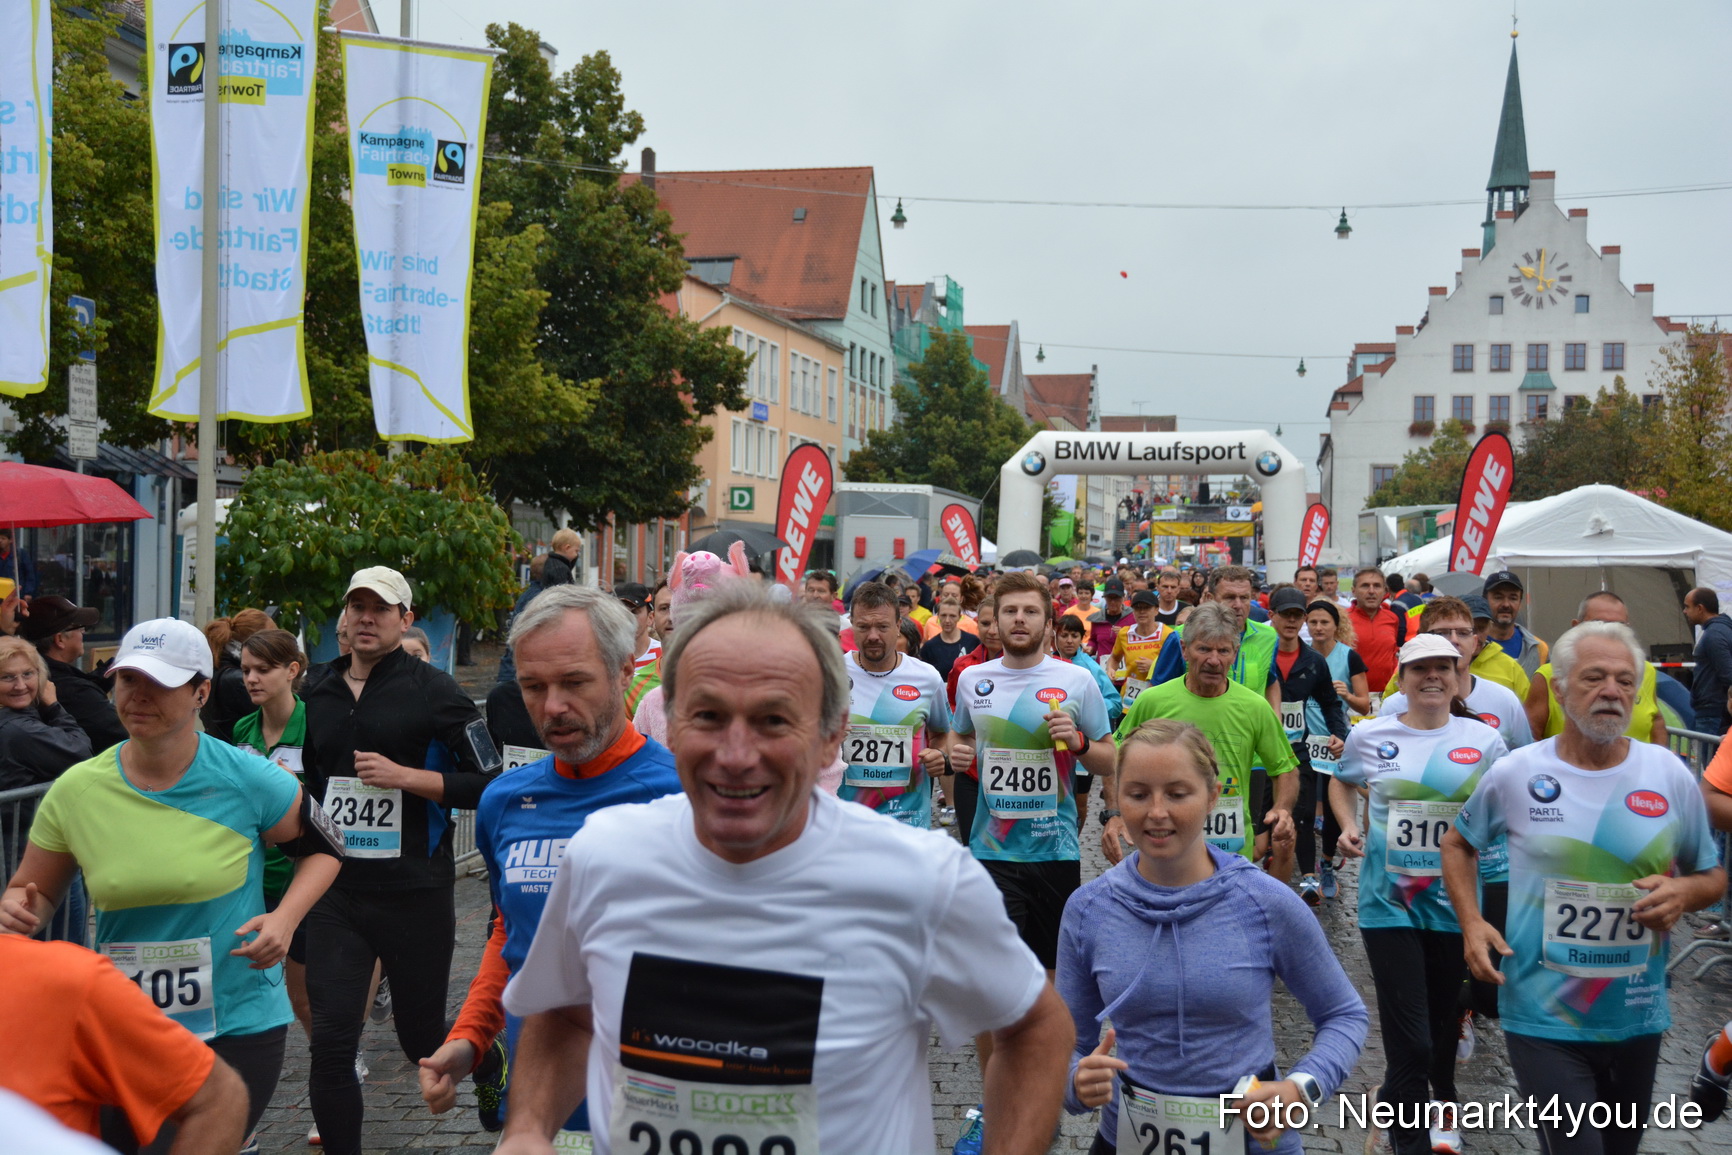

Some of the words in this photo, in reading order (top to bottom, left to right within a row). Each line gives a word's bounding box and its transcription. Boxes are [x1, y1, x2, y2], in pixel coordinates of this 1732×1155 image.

[360, 133, 425, 149] Kampagne
[360, 145, 431, 165] Fairtrade
[389, 168, 426, 181] Towns
[360, 249, 396, 271] Wir
[402, 252, 438, 276] sind
[1055, 440, 1122, 460] BMW
[1127, 441, 1247, 465] Laufsport
[1454, 453, 1506, 573] REWE
[779, 461, 824, 583] REWE
[1192, 525, 1214, 534] ZIEL
[1301, 511, 1326, 567] REWE
[896, 688, 918, 698] Hervis
[874, 726, 908, 736] BOCK
[851, 739, 905, 764] 2871
[1015, 751, 1051, 761] BOCK
[1452, 751, 1479, 760] Hervis
[863, 769, 893, 779] Robert
[990, 765, 1052, 793] 2486
[995, 798, 1045, 809] Alexander
[1630, 796, 1665, 810] Hervis
[331, 796, 395, 827] 2342
[1529, 807, 1564, 816] PARTL
[345, 834, 380, 847] ndreas
[1403, 853, 1434, 867] Anita
[520, 885, 549, 893] WASTE
[1555, 889, 1590, 899] NeuerMarkt
[1556, 903, 1645, 941] 2275
[143, 943, 200, 960] BOCK
[1568, 948, 1630, 964] Raimund
[654, 1033, 768, 1060] woodka
[624, 1091, 680, 1113] NeuerMarkt
[691, 1089, 799, 1116] BOCK
[1128, 1099, 1159, 1115] NeuerMarkt
[1140, 1122, 1210, 1155] 261
